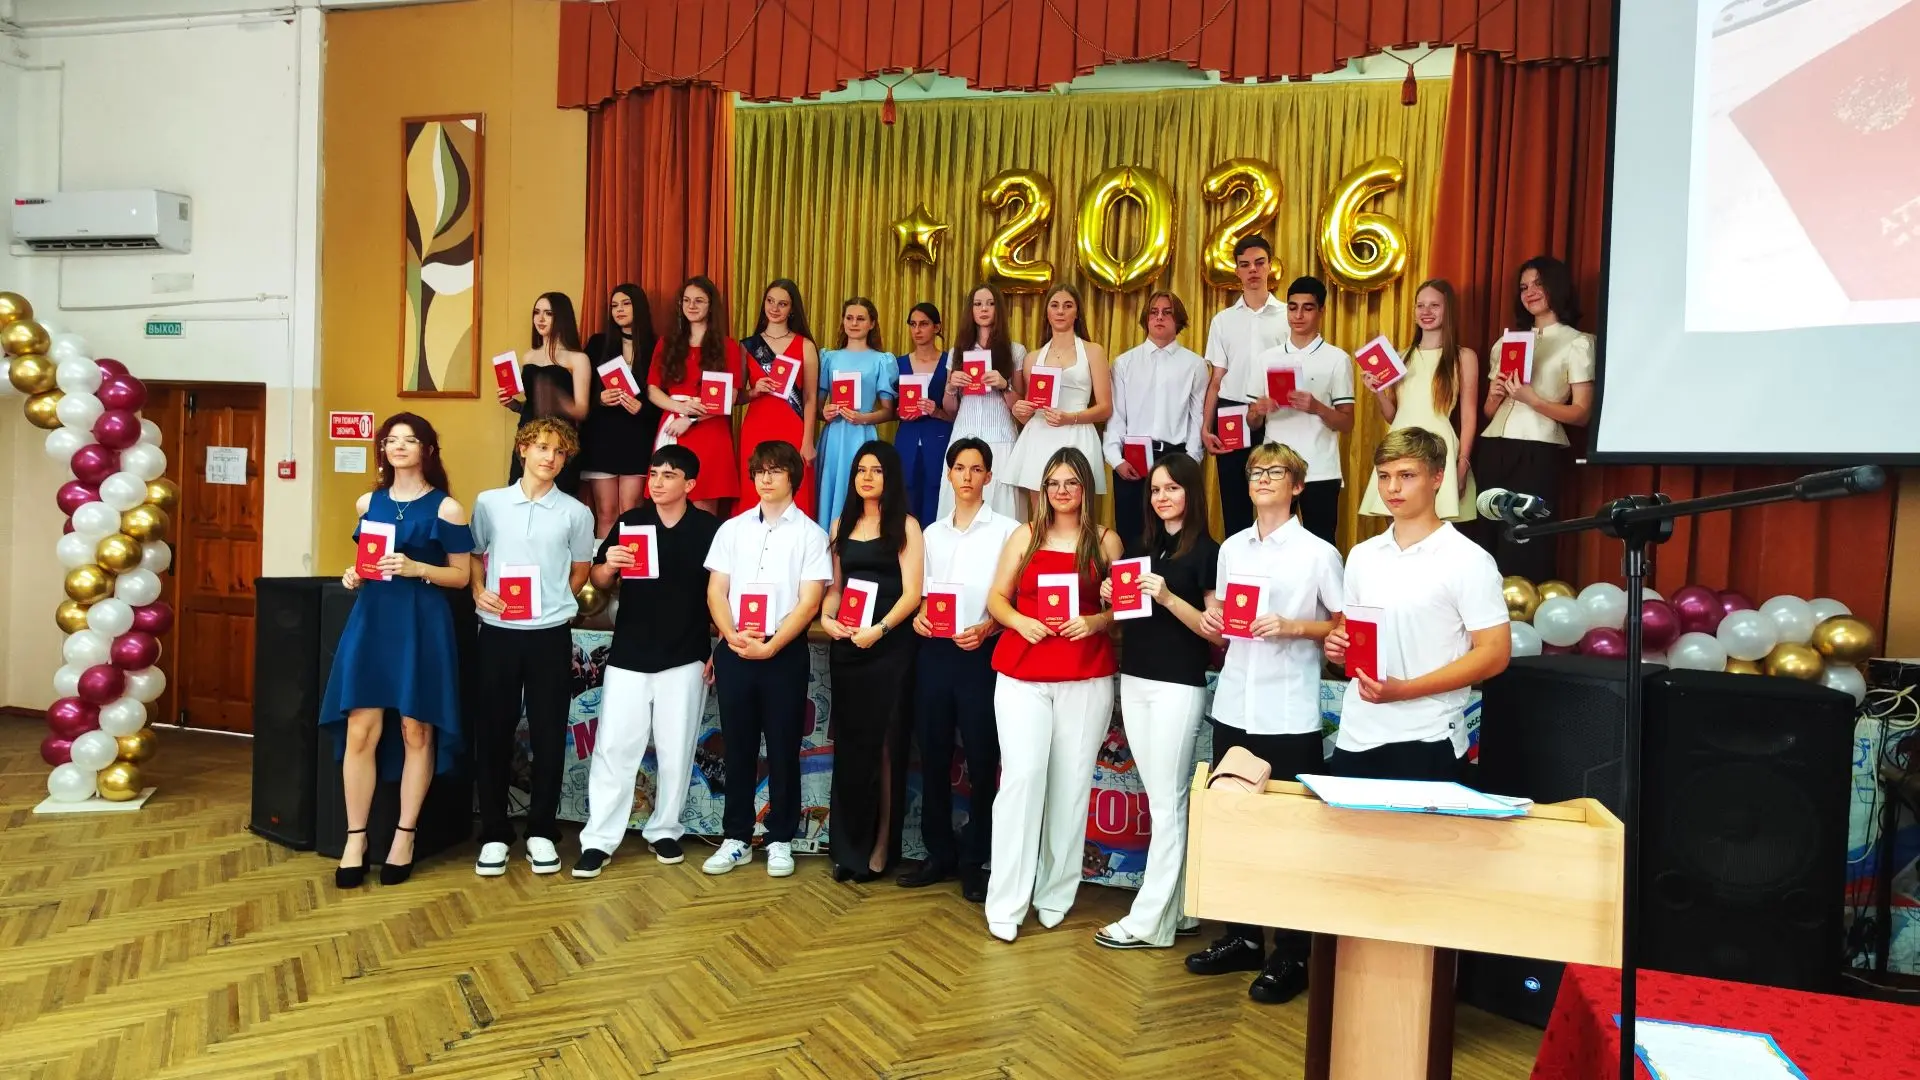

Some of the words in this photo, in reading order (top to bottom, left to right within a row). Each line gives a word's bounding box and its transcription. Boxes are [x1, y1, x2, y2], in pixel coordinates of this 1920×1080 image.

[981, 156, 1410, 294] 2026
[148, 323, 181, 334] ВЫХОД
[333, 416, 341, 424] ПРИ
[360, 418, 370, 434] 01
